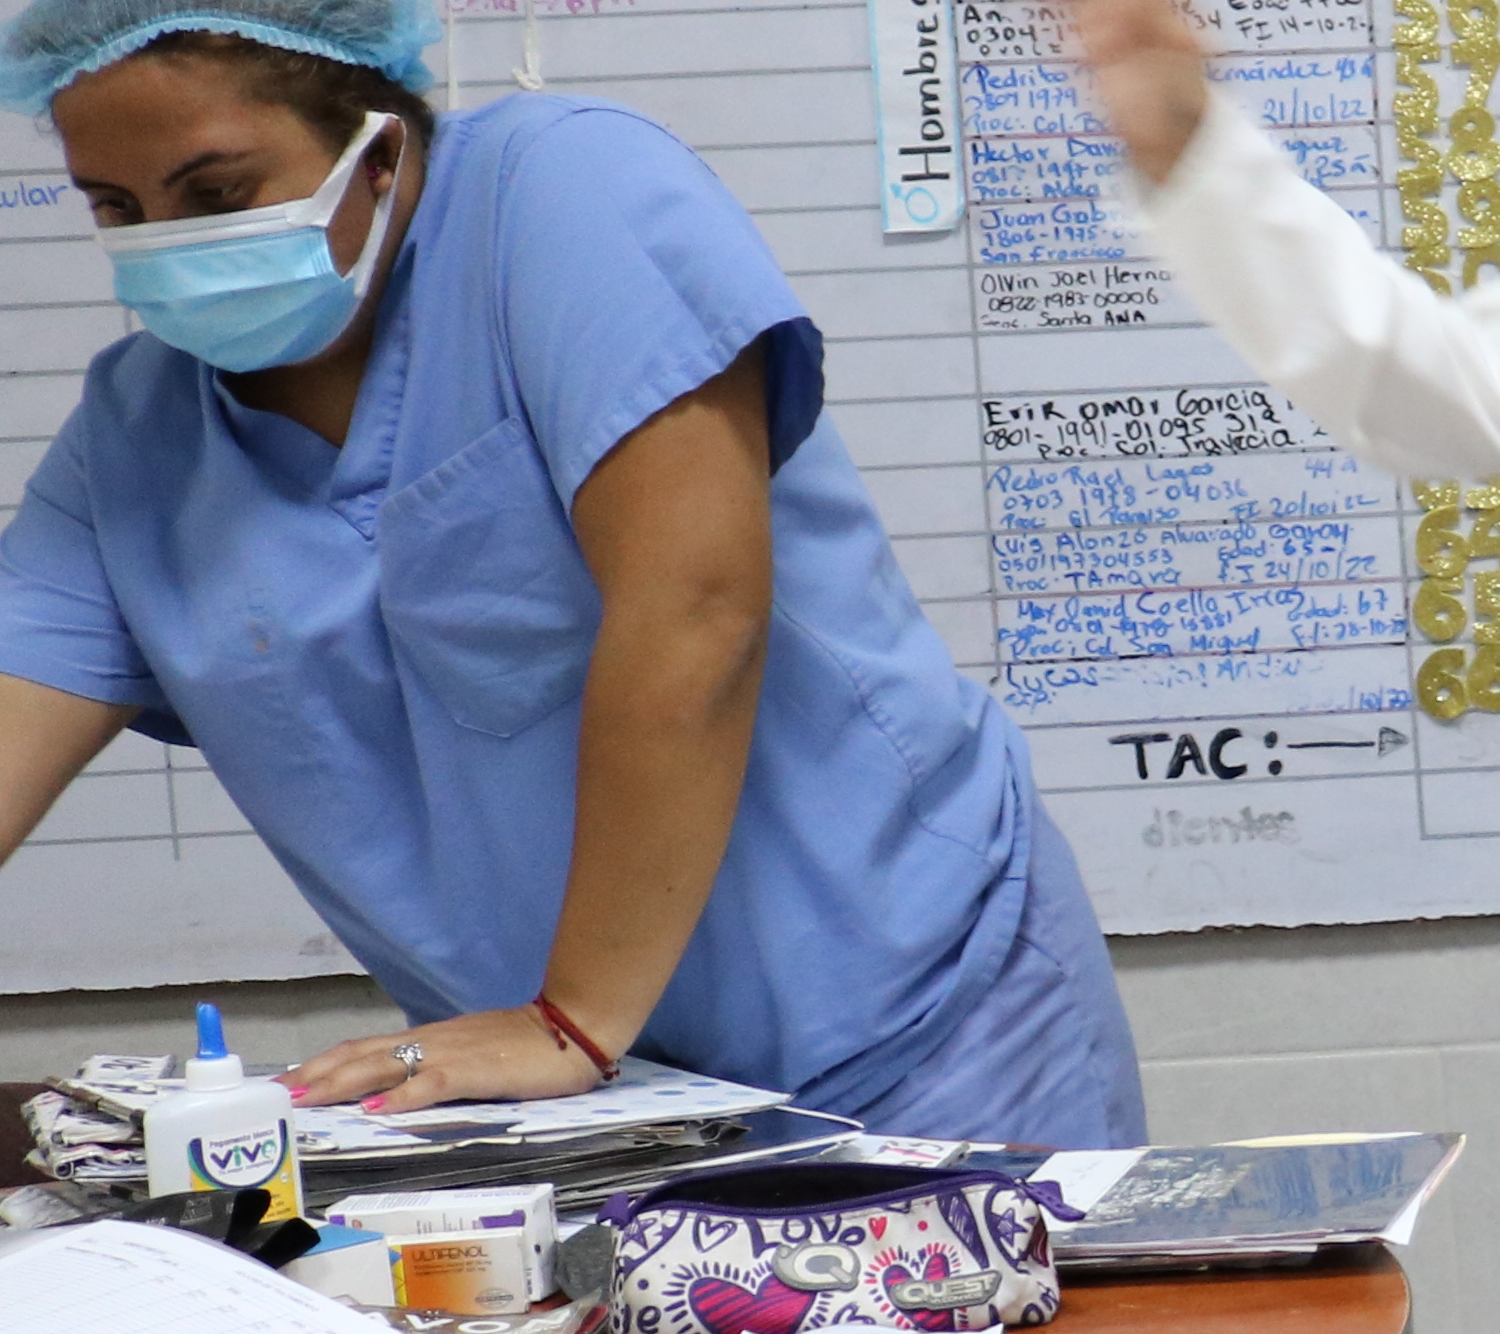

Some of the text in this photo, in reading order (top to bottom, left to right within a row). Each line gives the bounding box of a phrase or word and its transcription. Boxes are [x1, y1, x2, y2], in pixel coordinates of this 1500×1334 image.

[1108, 727, 1283, 780] TAC:
[412, 1246, 488, 1260] ULTIFENOL
[905, 1279, 995, 1303] QUEST
